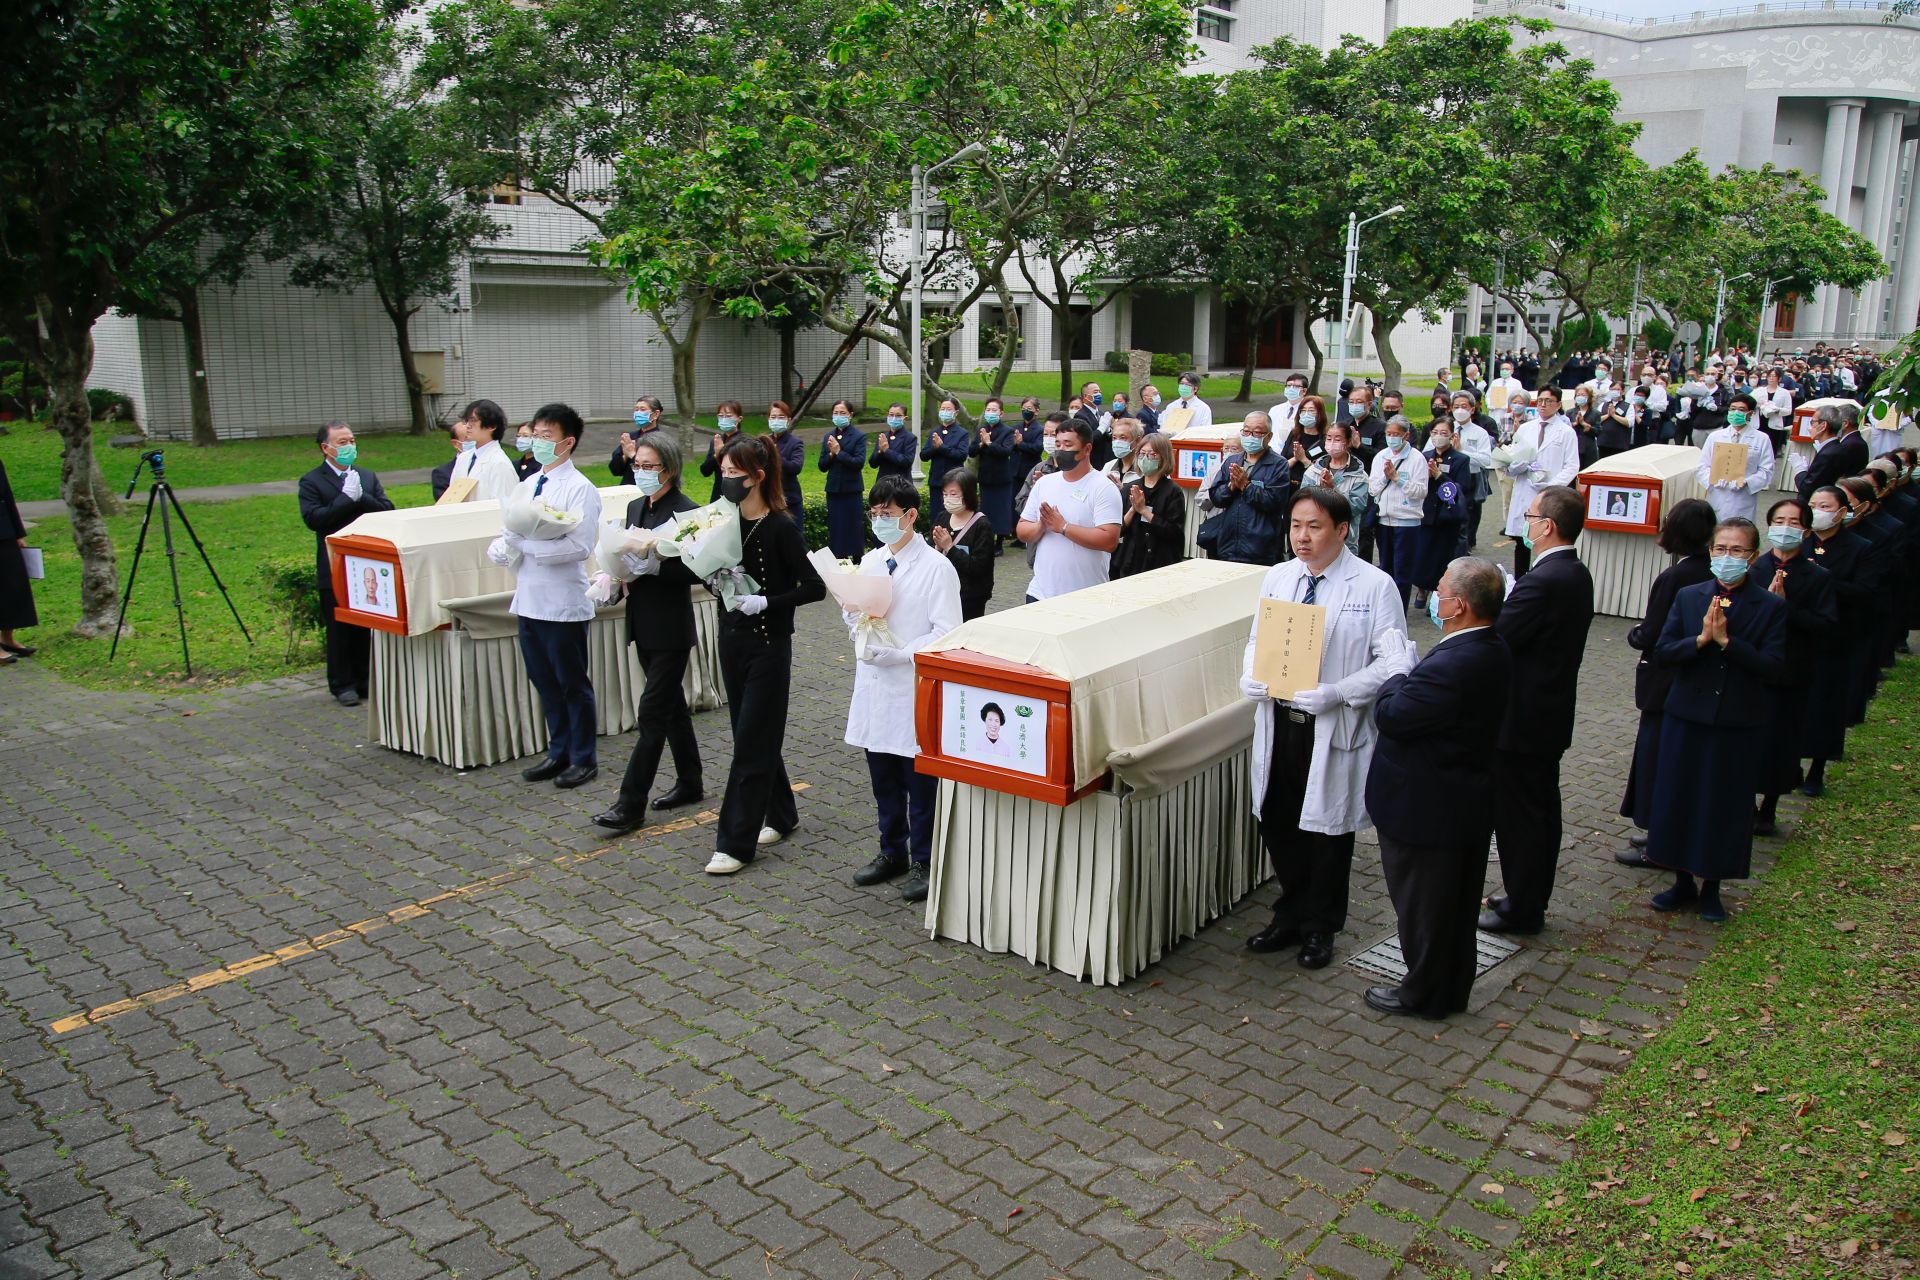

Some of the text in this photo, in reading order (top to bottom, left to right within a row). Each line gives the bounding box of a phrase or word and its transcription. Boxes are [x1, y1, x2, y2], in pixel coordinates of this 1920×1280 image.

[1443, 486, 1452, 498] 3
[1019, 723, 1027, 760] 慈濟大學
